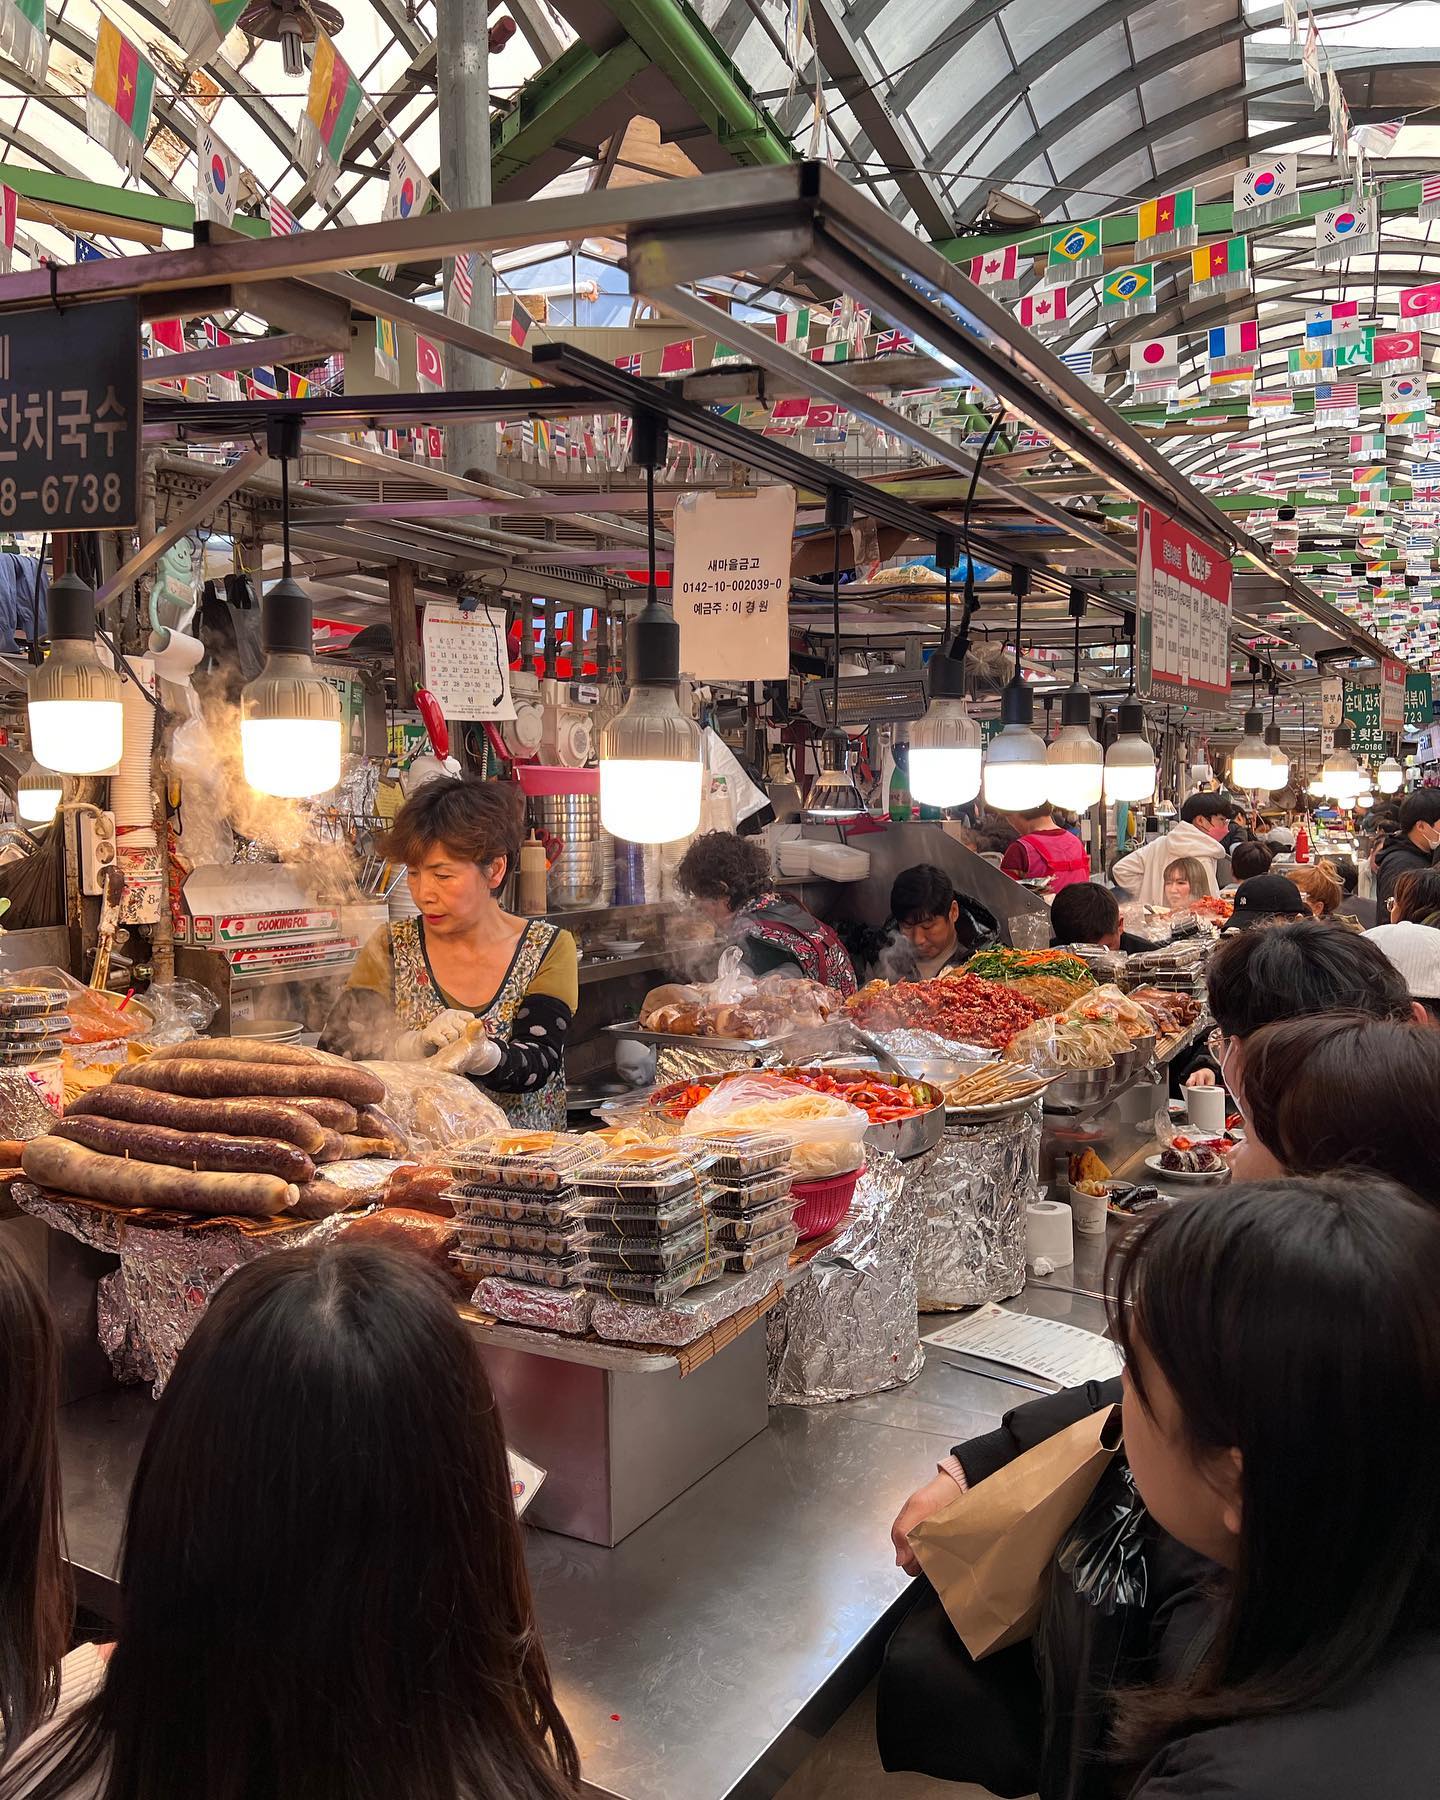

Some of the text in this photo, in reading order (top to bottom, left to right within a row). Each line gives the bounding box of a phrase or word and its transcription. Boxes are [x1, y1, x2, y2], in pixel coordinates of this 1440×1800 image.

[0, 472, 121, 516] 8-6738
[708, 557, 760, 572] 새마을금고
[682, 578, 782, 592] 0142-10-002039-0
[694, 602, 722, 615] 예금주
[257, 917, 292, 932] COOKING
